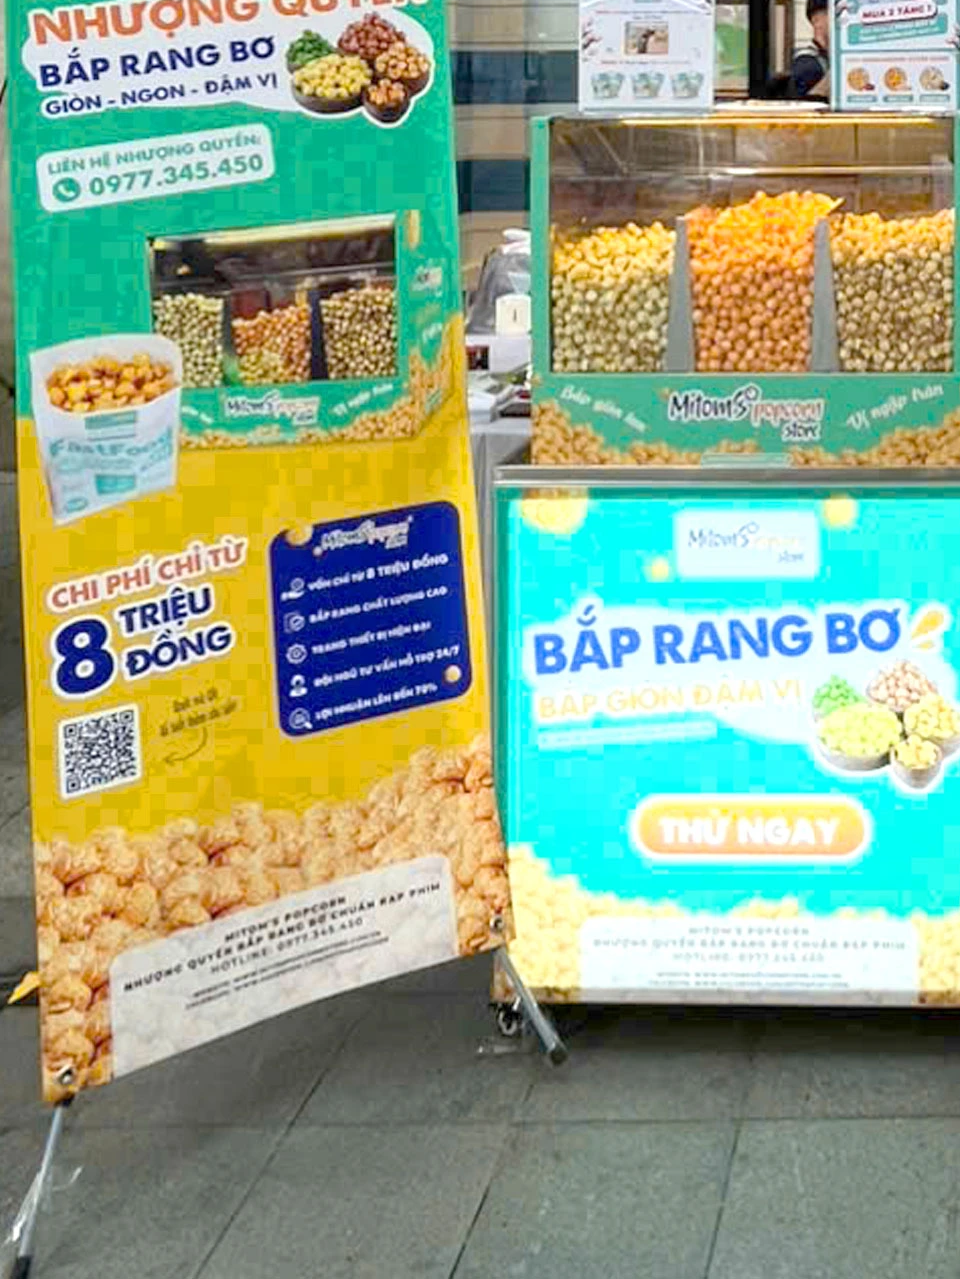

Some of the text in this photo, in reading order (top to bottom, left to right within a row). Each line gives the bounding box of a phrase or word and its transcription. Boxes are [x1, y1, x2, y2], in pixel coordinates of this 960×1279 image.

[40, 35, 277, 88] BẮP RANG BƠ
[45, 91, 102, 117] GIÒN
[121, 84, 186, 106] NGON
[205, 73, 252, 96] ĐẬM
[258, 72, 279, 91] VỊ
[47, 155, 87, 176] LIÊN
[90, 152, 112, 172] HỆ
[116, 142, 196, 167] NHƯỢNG
[89, 153, 264, 198] 0977.345.450
[51, 539, 246, 609] CHI PHÍ CHỈ TỪ
[119, 586, 213, 636] TRIỆU
[56, 619, 115, 696] 8
[125, 624, 233, 677] ĐỒNG
[534, 604, 902, 676] BẮP RANG BƠ
[736, 815, 842, 847] NGAY
